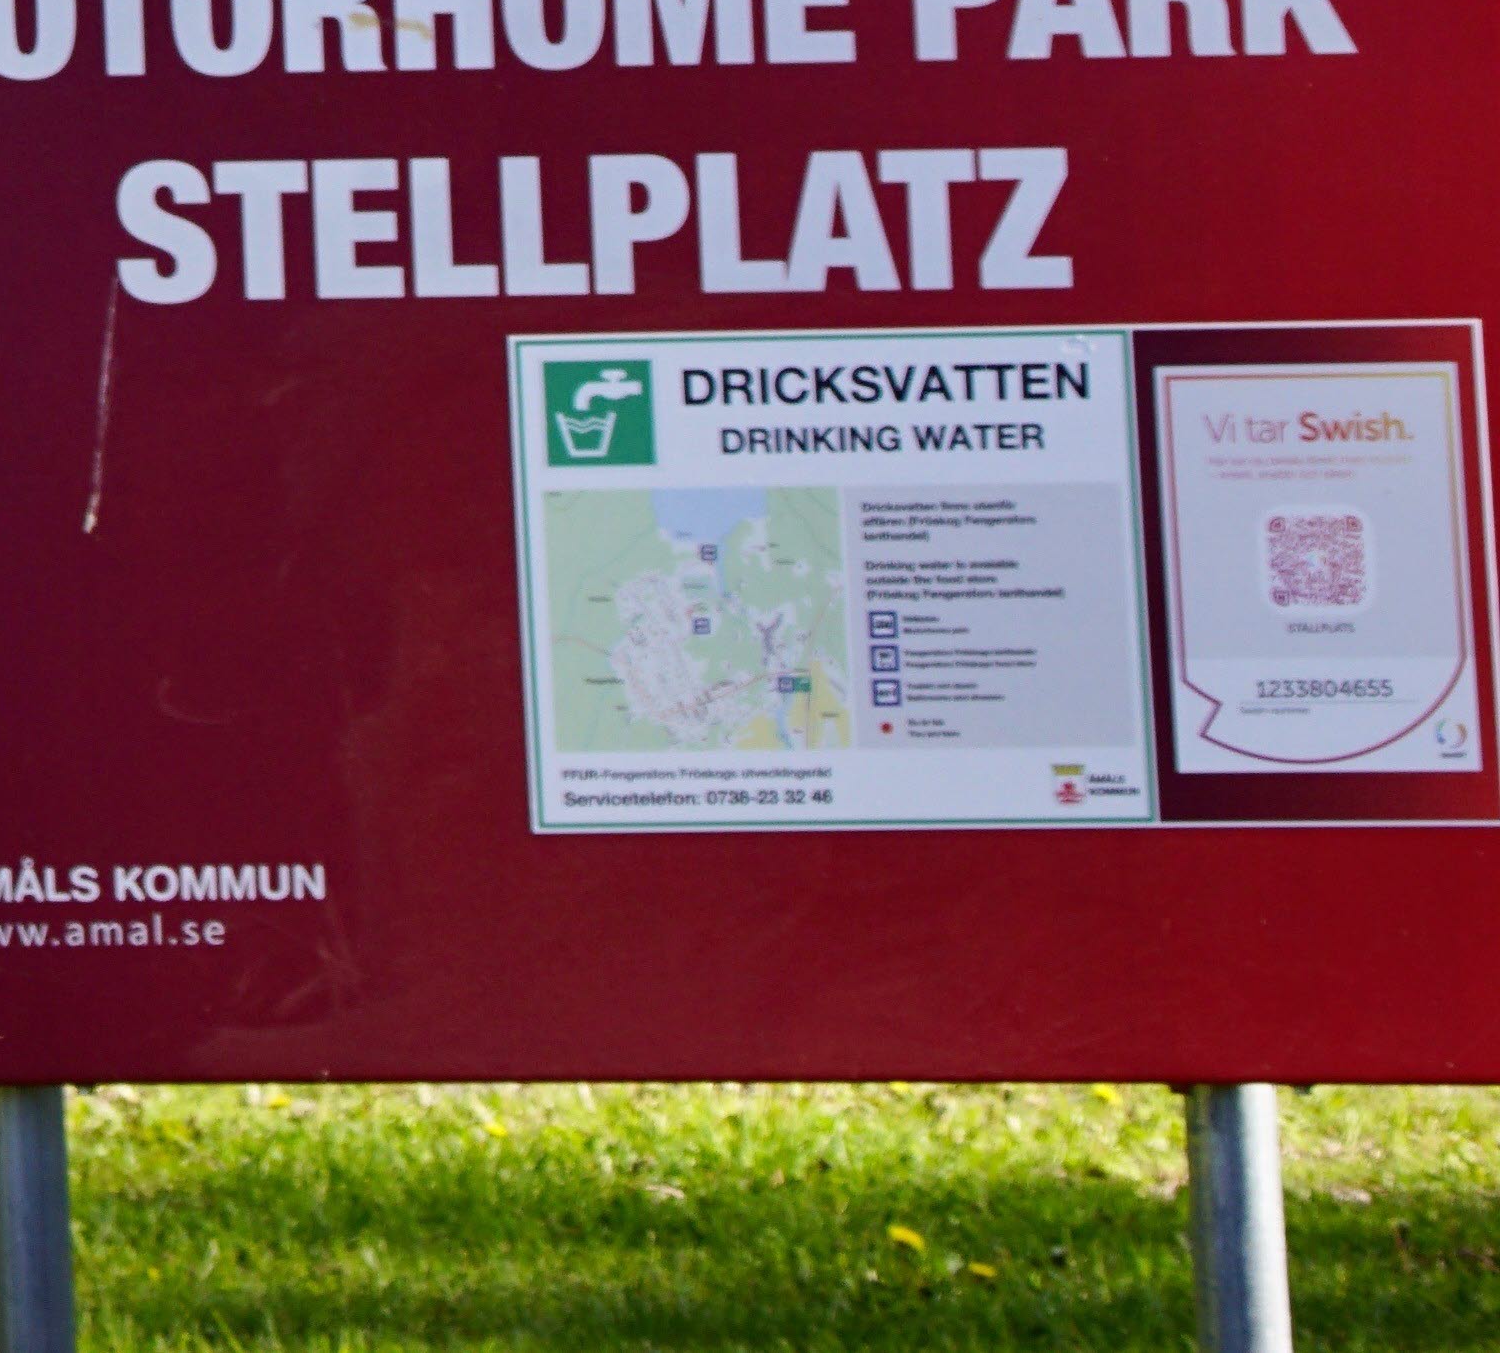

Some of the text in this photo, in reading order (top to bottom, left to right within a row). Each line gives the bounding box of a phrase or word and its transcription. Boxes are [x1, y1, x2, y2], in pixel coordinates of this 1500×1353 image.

[114, 146, 1075, 304] STELLPLATZ
[682, 363, 1090, 406] DRICKSVATTEN
[721, 423, 1044, 455] DRINKING WATER
[1203, 410, 1414, 443] Vi tar Swish.
[1257, 679, 1394, 697] 1233804655
[114, 863, 326, 902] KOMMUN
